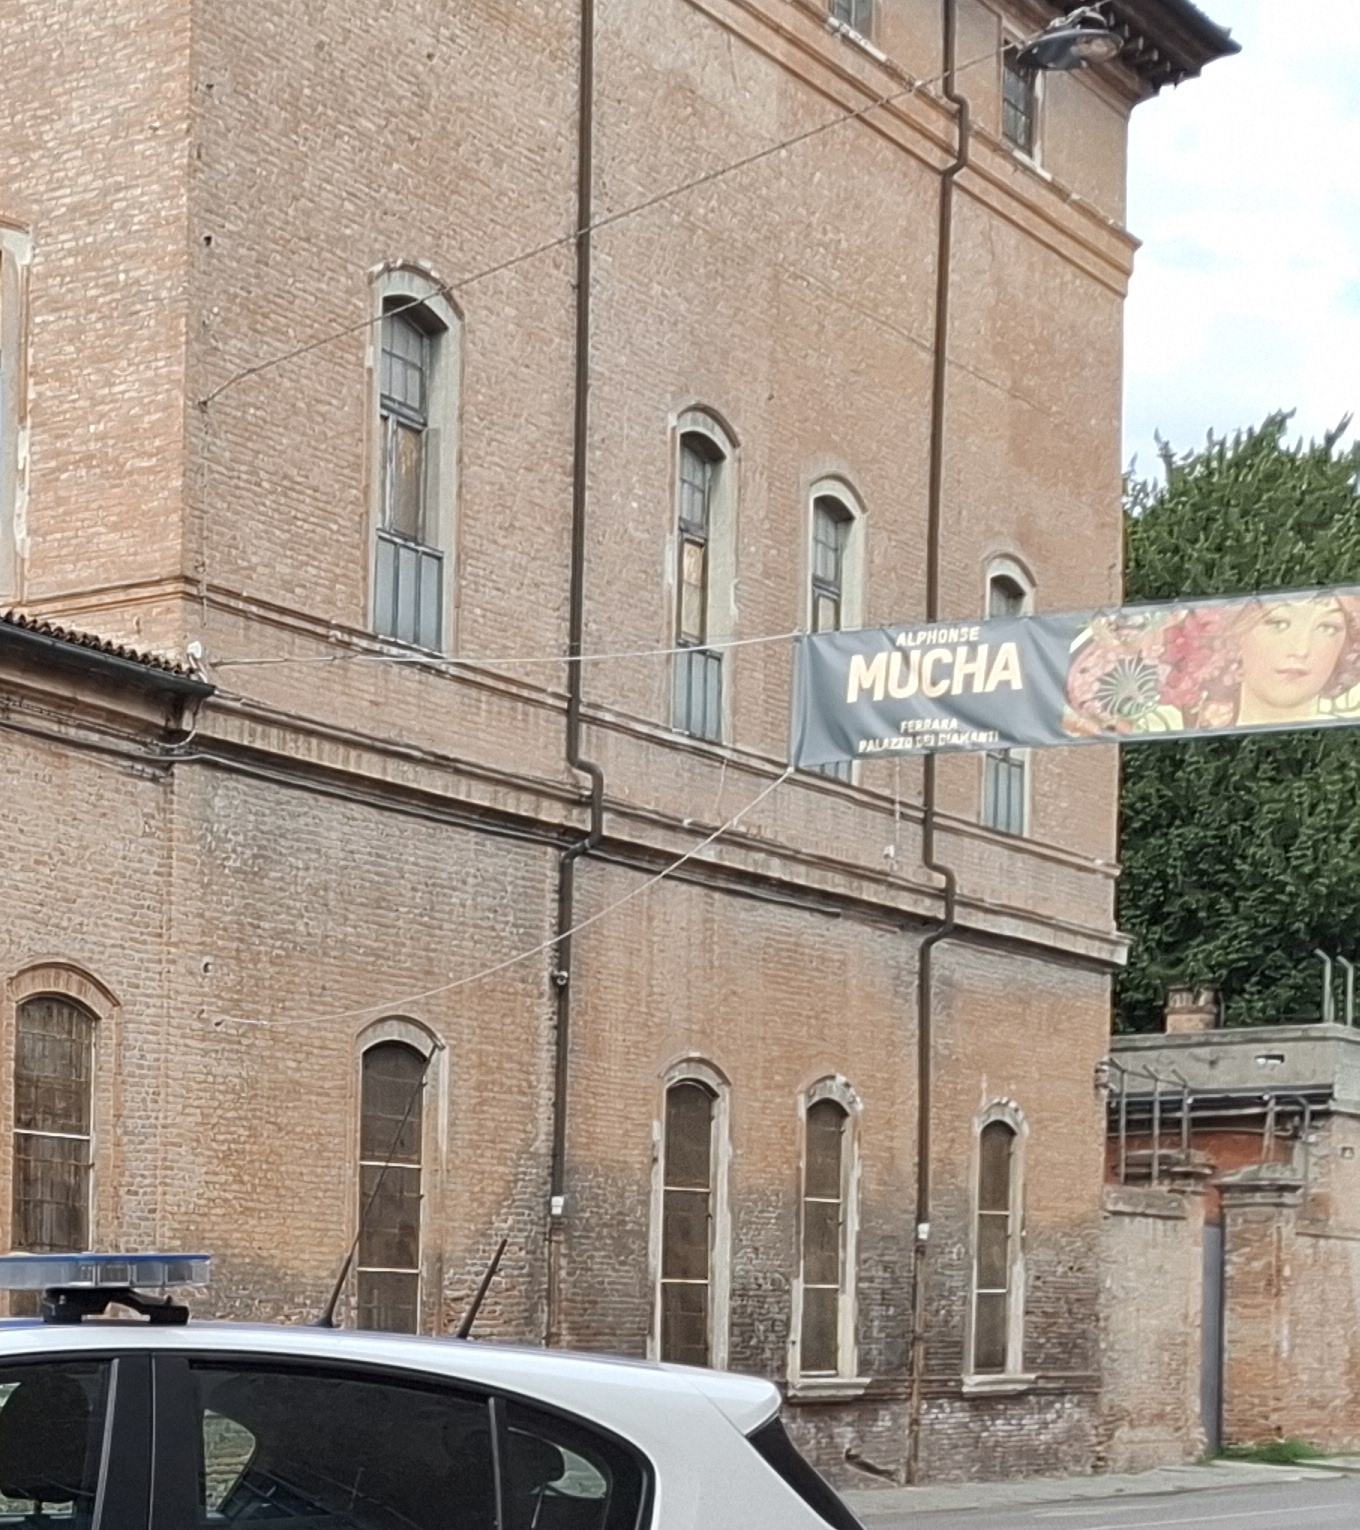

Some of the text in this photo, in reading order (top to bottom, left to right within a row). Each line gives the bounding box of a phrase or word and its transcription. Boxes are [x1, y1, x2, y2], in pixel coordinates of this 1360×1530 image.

[896, 626, 980, 646] ALPHONSE
[846, 642, 1023, 703] MUCHA
[900, 718, 958, 733] FERRARA
[858, 735, 913, 753] PALAZZO
